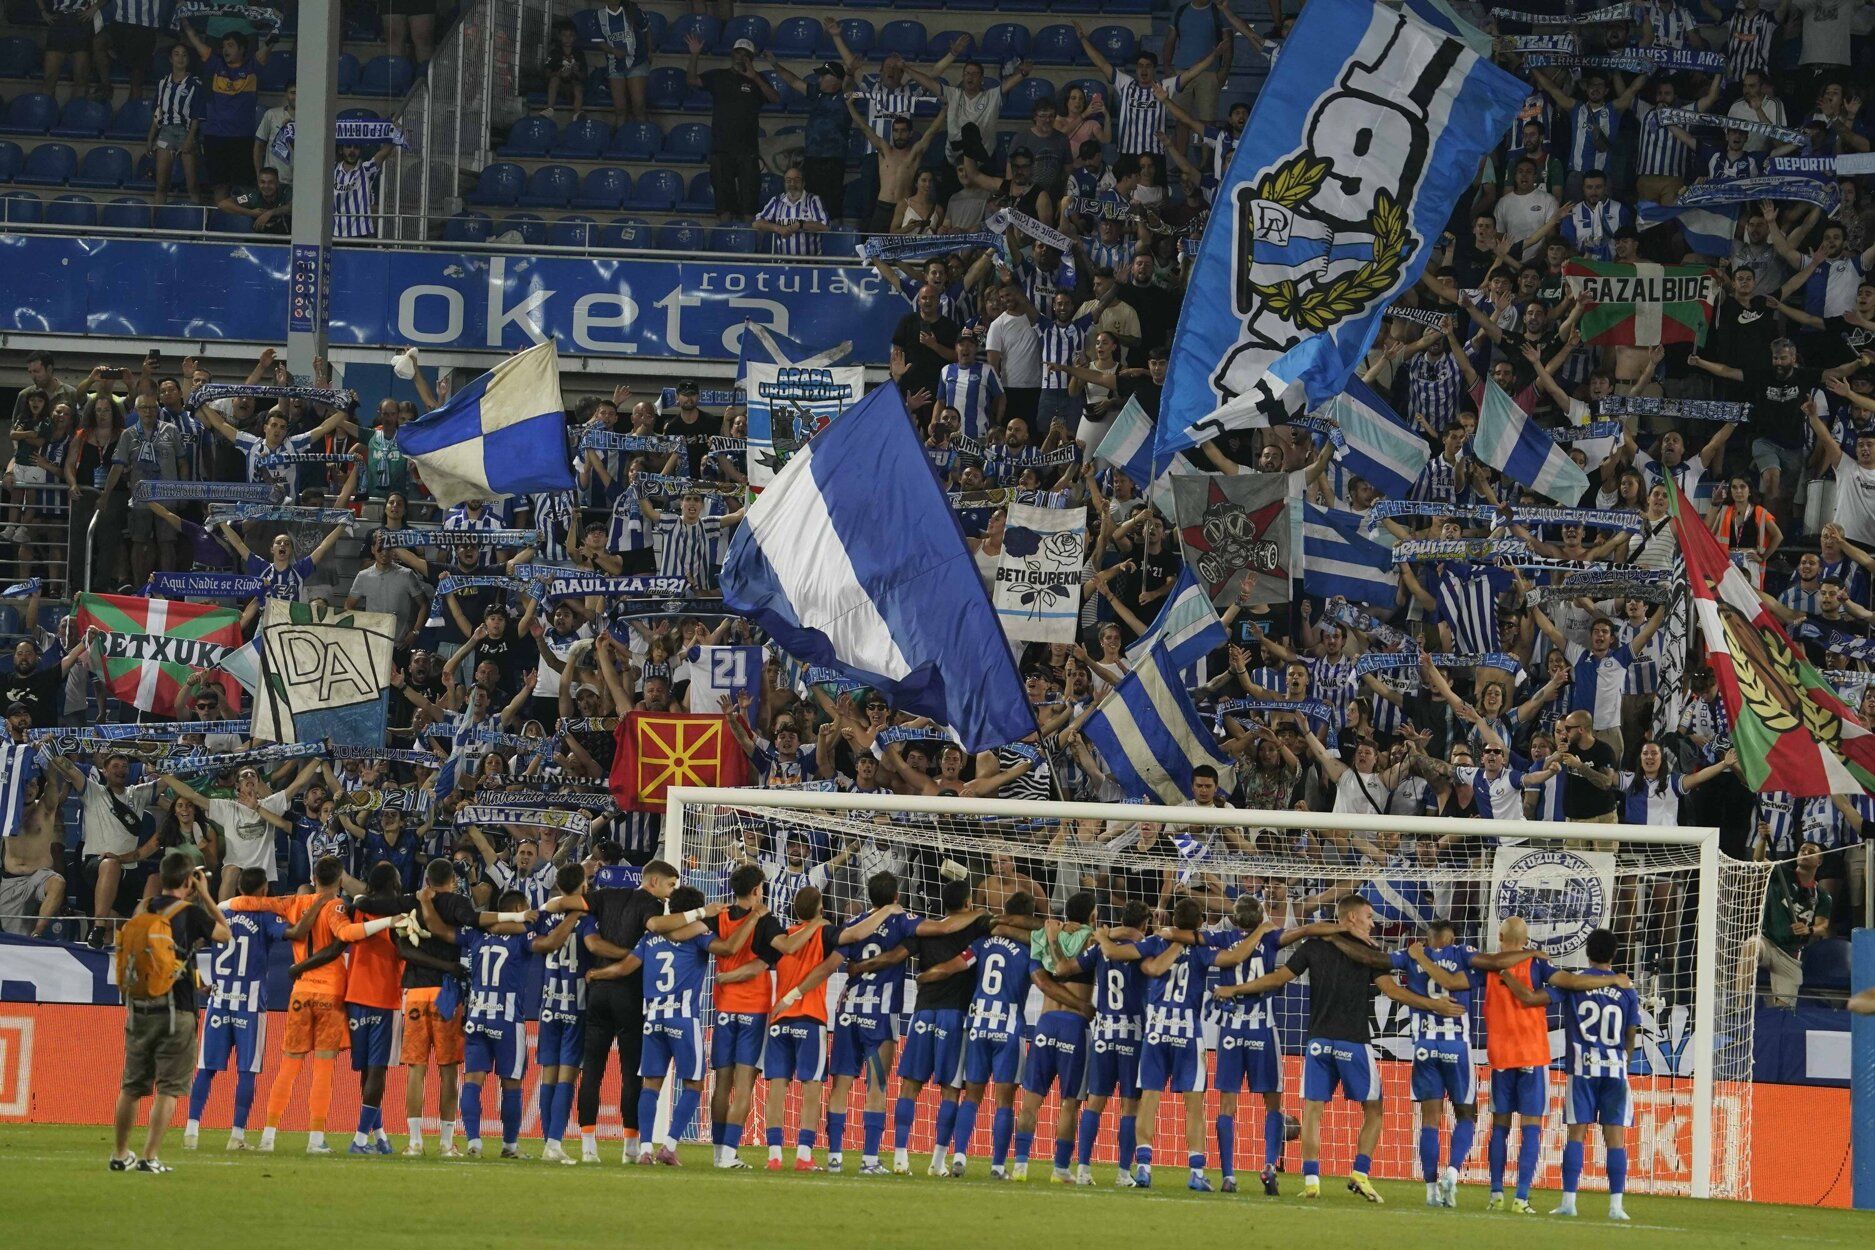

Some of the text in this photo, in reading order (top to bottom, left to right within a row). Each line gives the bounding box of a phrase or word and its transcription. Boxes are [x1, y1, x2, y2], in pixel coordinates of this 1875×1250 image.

[398, 256, 790, 357] oketa
[1582, 276, 1713, 303] GAZALBIDE
[777, 367, 834, 385] ARABA
[383, 532, 517, 548] ZERUA ERREKO DUGU
[160, 576, 264, 591] Aquí Nadie se Rinde
[648, 577, 686, 594] 1921
[996, 566, 1082, 585] BETI GUREKIN
[278, 629, 374, 702] DA
[714, 651, 747, 687] 21
[1760, 799, 1792, 813] betway
[215, 935, 250, 977] 21
[480, 945, 510, 987] 17
[655, 951, 675, 993] 3
[981, 953, 1006, 996] 6
[1107, 968, 1125, 1011] 8
[1163, 960, 1190, 1003] 19
[1577, 1000, 1623, 1046] 20
